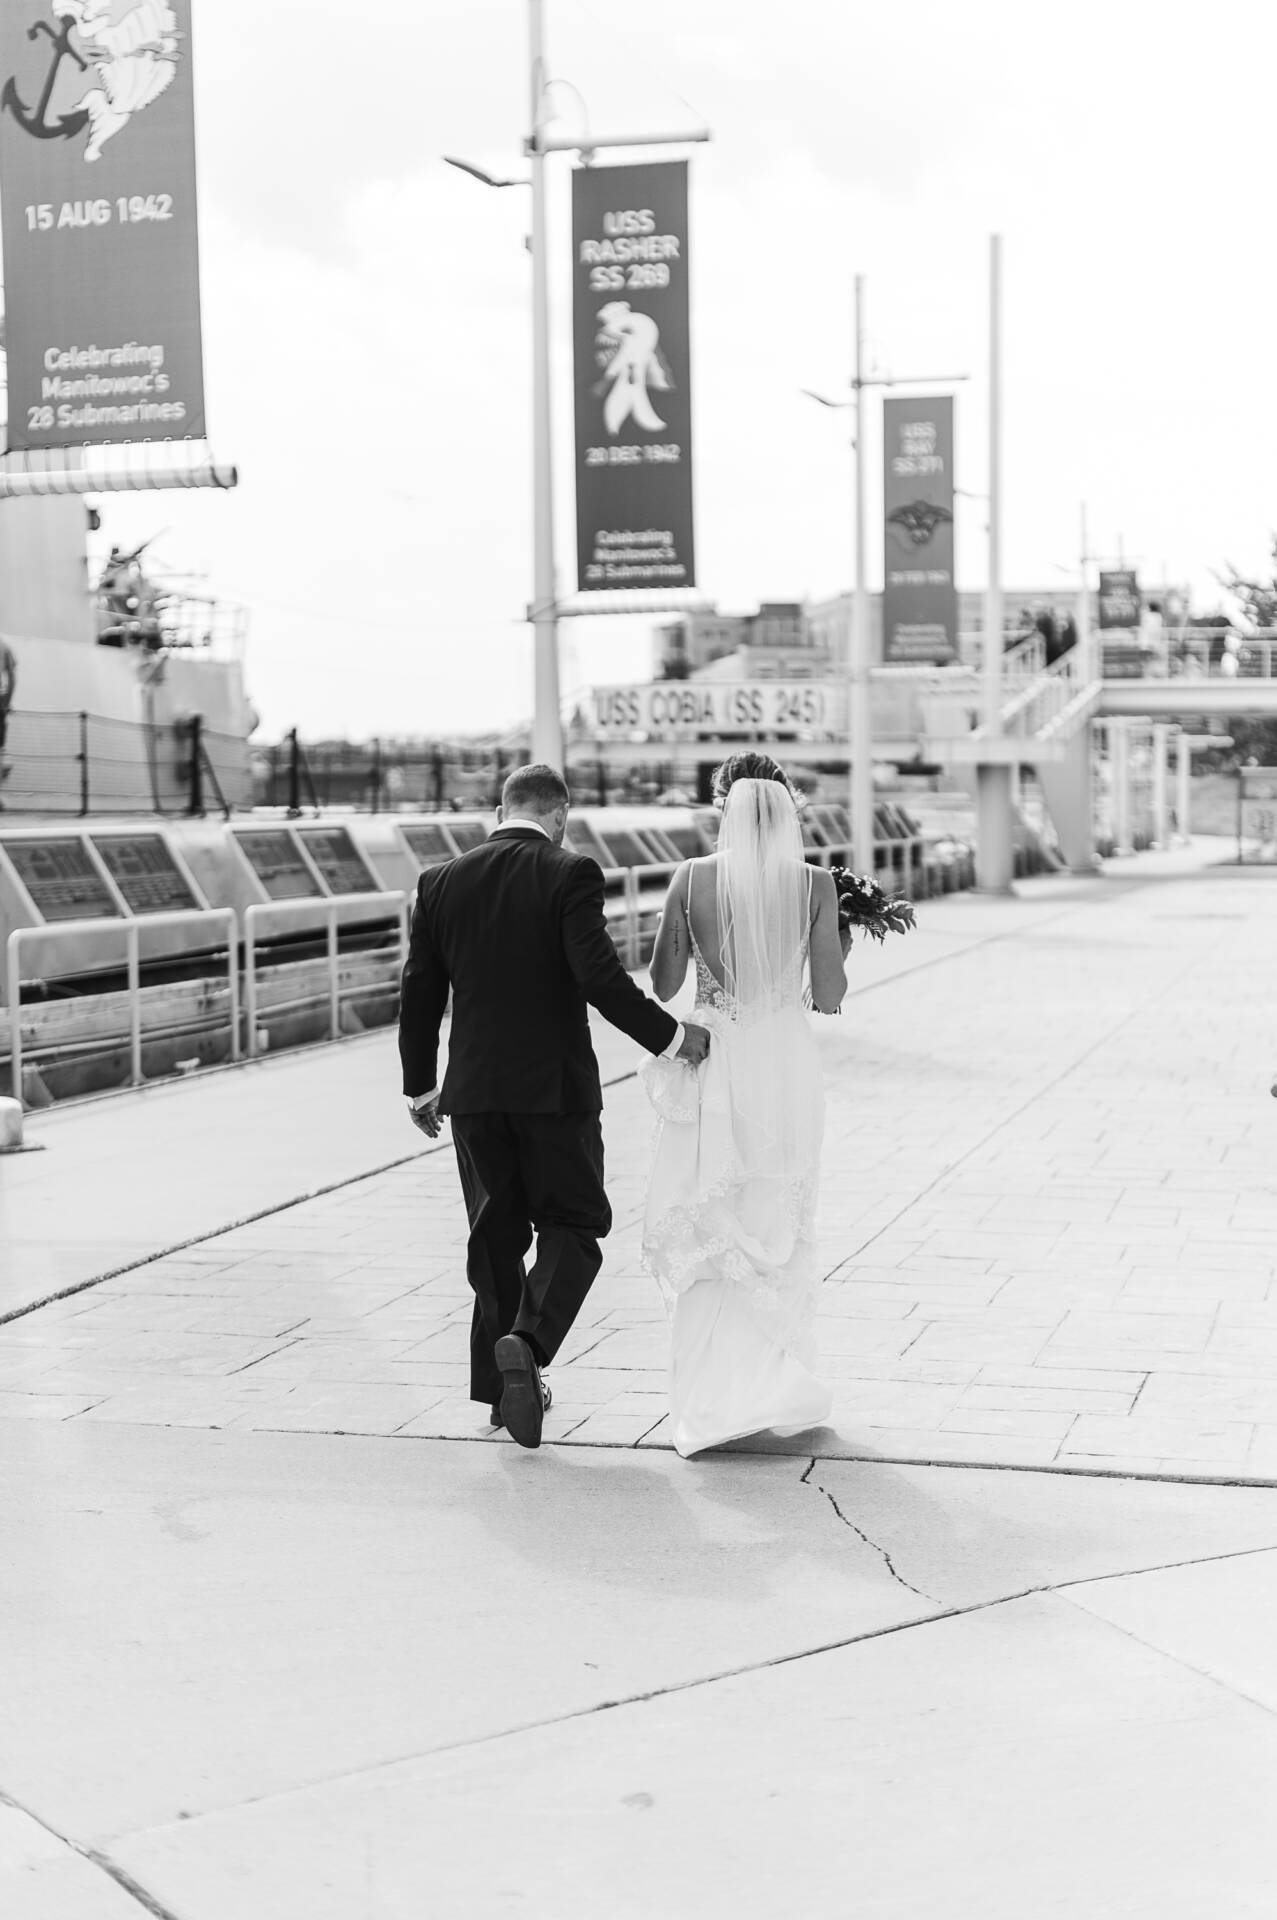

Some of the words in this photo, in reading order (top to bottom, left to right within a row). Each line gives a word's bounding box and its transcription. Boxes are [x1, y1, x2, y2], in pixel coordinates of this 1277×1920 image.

[25, 204, 54, 232] 15
[57, 199, 111, 230] AUG
[116, 193, 174, 224] 1942
[603, 209, 656, 236] USS
[579, 235, 681, 264] RASHER
[588, 265, 625, 292] SS
[626, 263, 671, 290] 269
[44, 341, 164, 371] Celebrating
[42, 369, 170, 400] Manitowoc's
[27, 404, 55, 431] 28
[57, 399, 187, 428] Submarines
[608, 445, 642, 466] DEC
[643, 444, 681, 464] 1942
[595, 529, 674, 547] Celebrating
[597, 690, 639, 726] USS
[651, 690, 714, 725] COBIA
[725, 688, 763, 725] (SS
[776, 688, 824, 725] 245)
